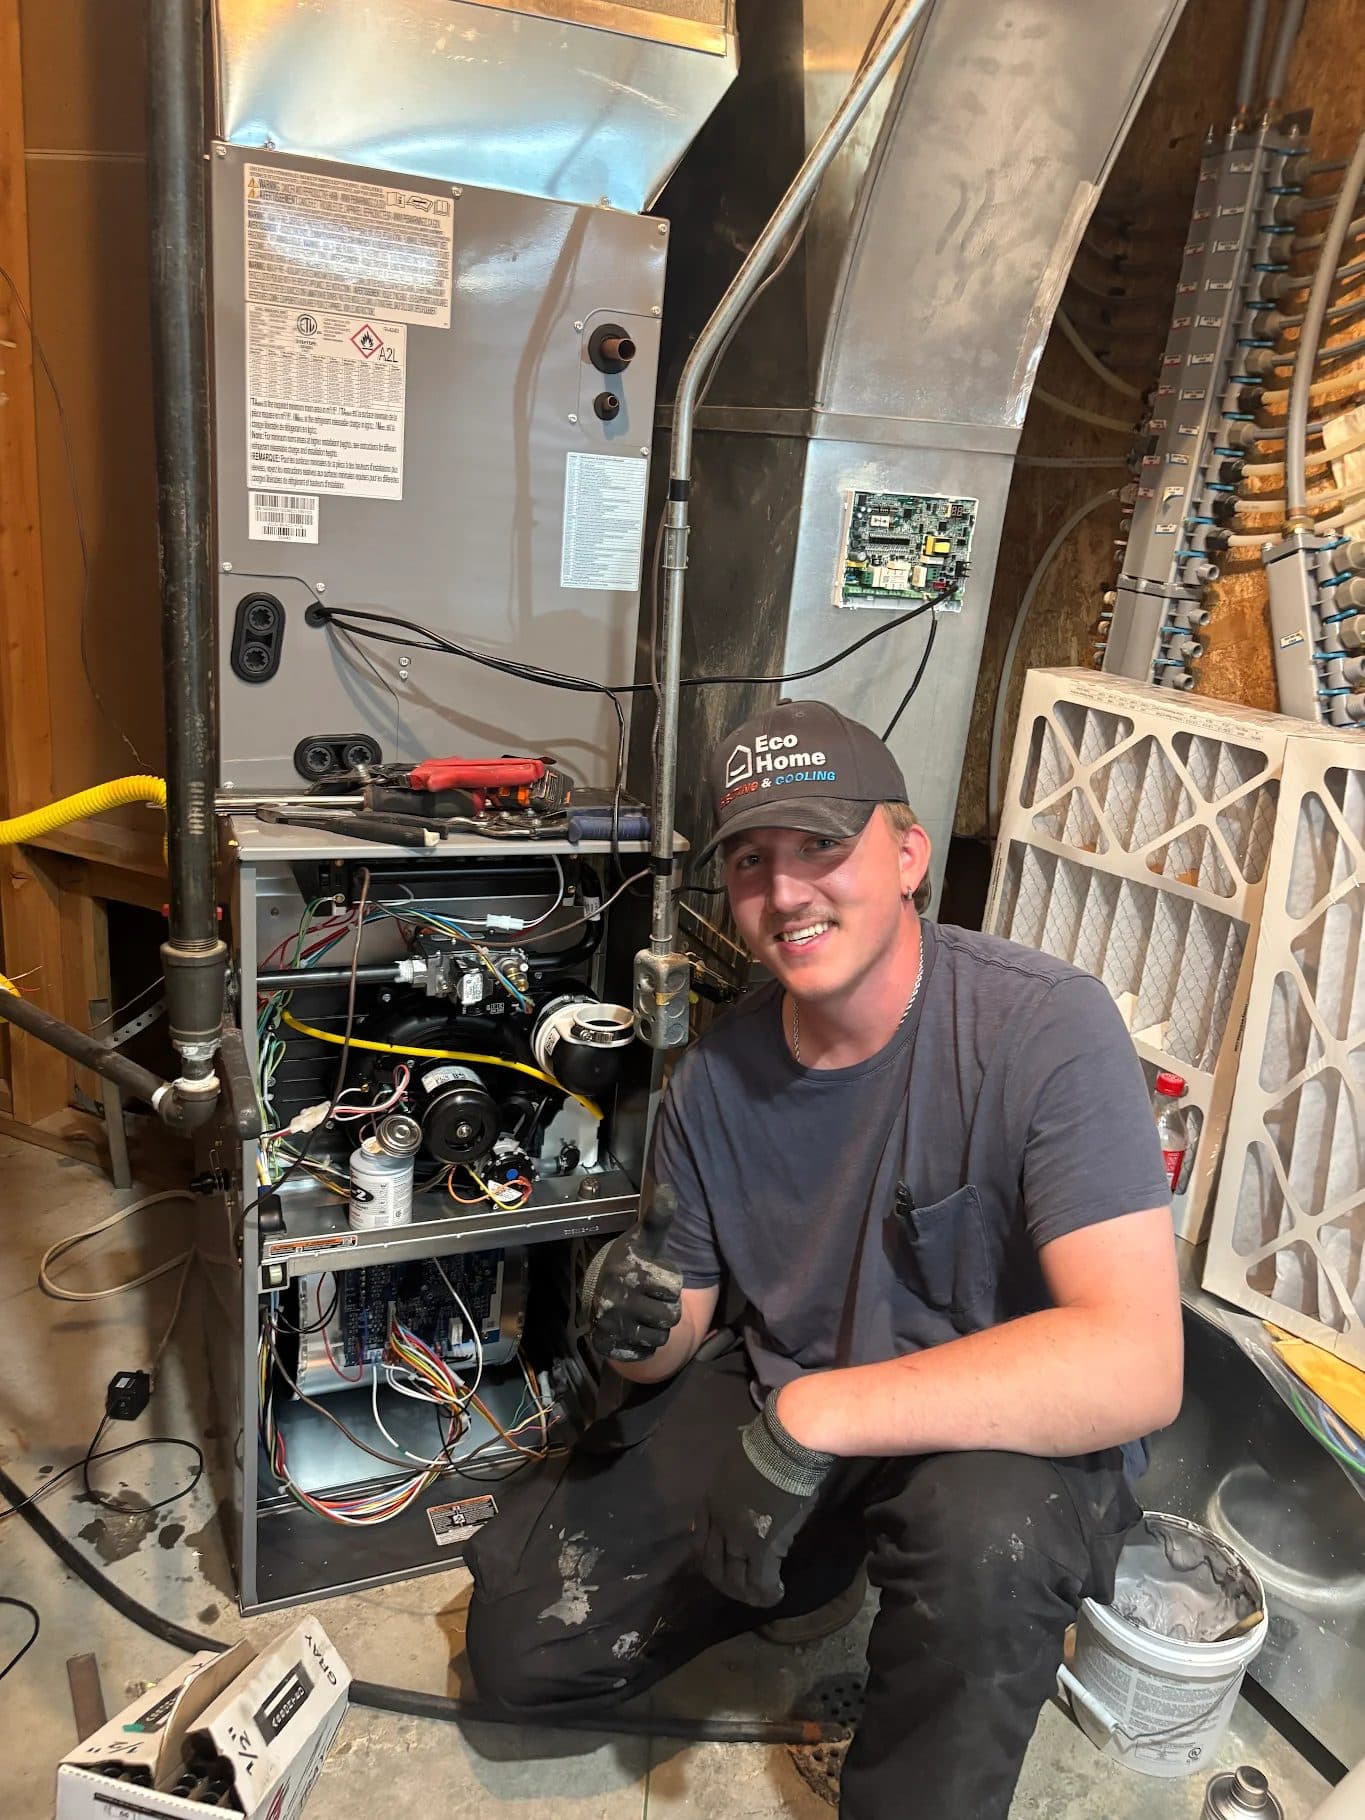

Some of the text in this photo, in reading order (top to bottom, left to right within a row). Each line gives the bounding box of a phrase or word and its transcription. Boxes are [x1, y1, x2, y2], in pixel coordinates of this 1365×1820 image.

[379, 346, 399, 363] A2L
[755, 734, 798, 753] Eco
[756, 751, 826, 773] Home
[761, 778, 772, 788] &
[775, 770, 836, 785] COOLING
[305, 1635, 337, 1686] GRAY
